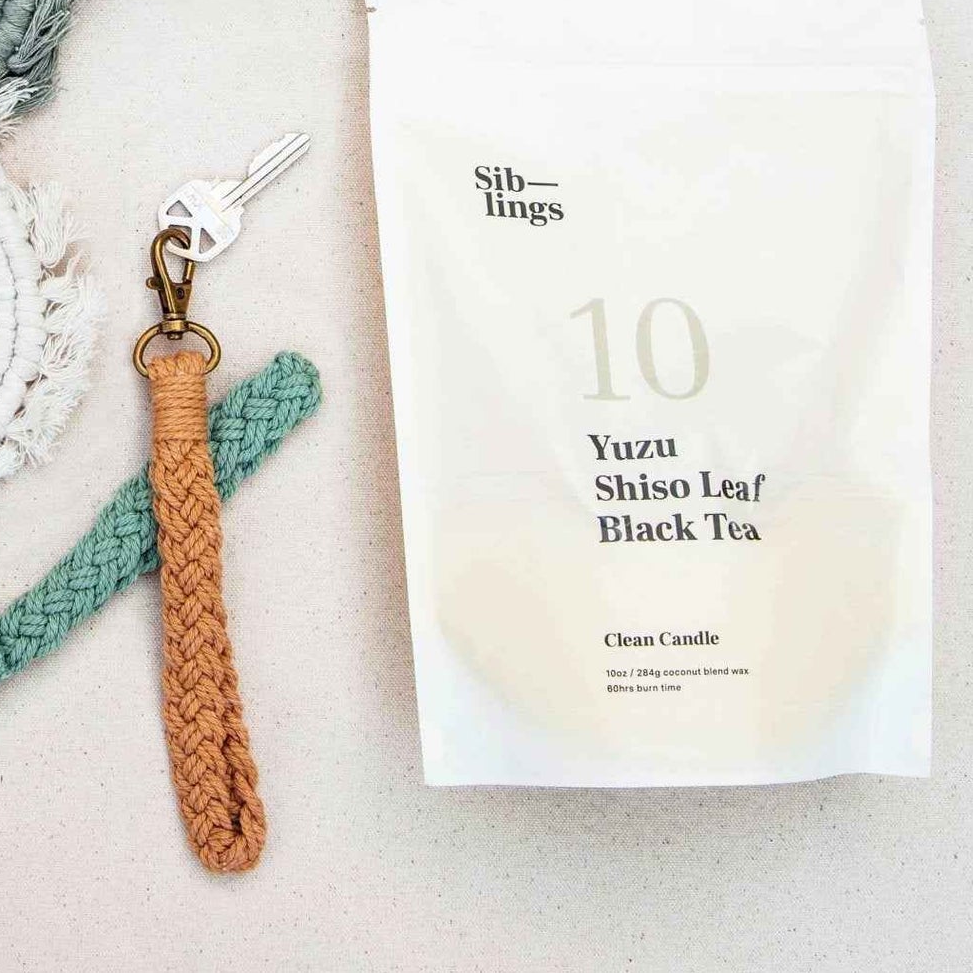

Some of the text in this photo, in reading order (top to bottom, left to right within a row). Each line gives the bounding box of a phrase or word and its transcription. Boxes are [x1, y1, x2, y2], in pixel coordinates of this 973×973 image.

[484, 191, 565, 227] lings
[569, 296, 711, 401] 10
[587, 433, 679, 461] Yuzu
[595, 470, 766, 502] Shiso Leaf
[597, 512, 762, 543] Black Tea
[604, 630, 720, 648] Clean Candle
[605, 669, 628, 678] 10oz
[637, 668, 662, 679] 284g
[662, 668, 702, 677] coconut
[703, 666, 730, 676] blend
[731, 667, 750, 676] wax
[606, 683, 682, 693] 60hrs burn time
